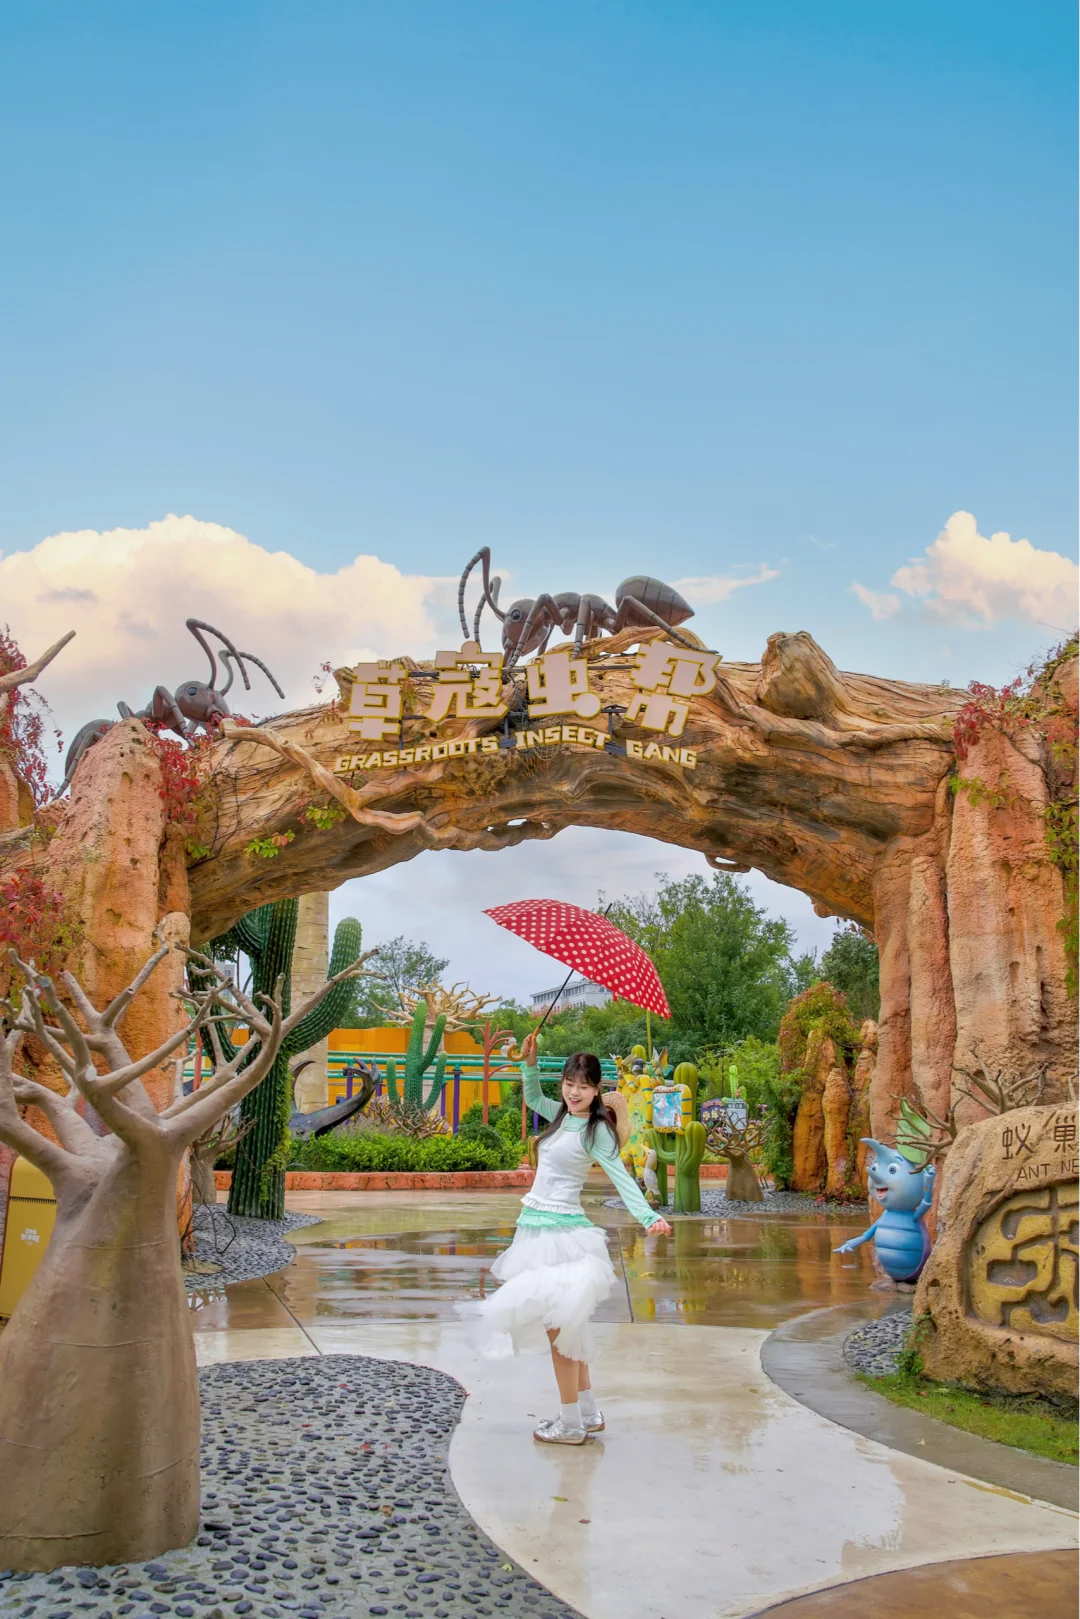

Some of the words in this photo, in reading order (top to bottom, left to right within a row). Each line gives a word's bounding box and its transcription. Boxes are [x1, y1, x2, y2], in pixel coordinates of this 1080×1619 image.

[348, 640, 723, 741] 草寇虫帮
[333, 736, 499, 773] GRASSROOTS
[515, 725, 611, 750] INSECT
[626, 739, 697, 769] GANG
[1016, 1163, 1051, 1181] ANT
